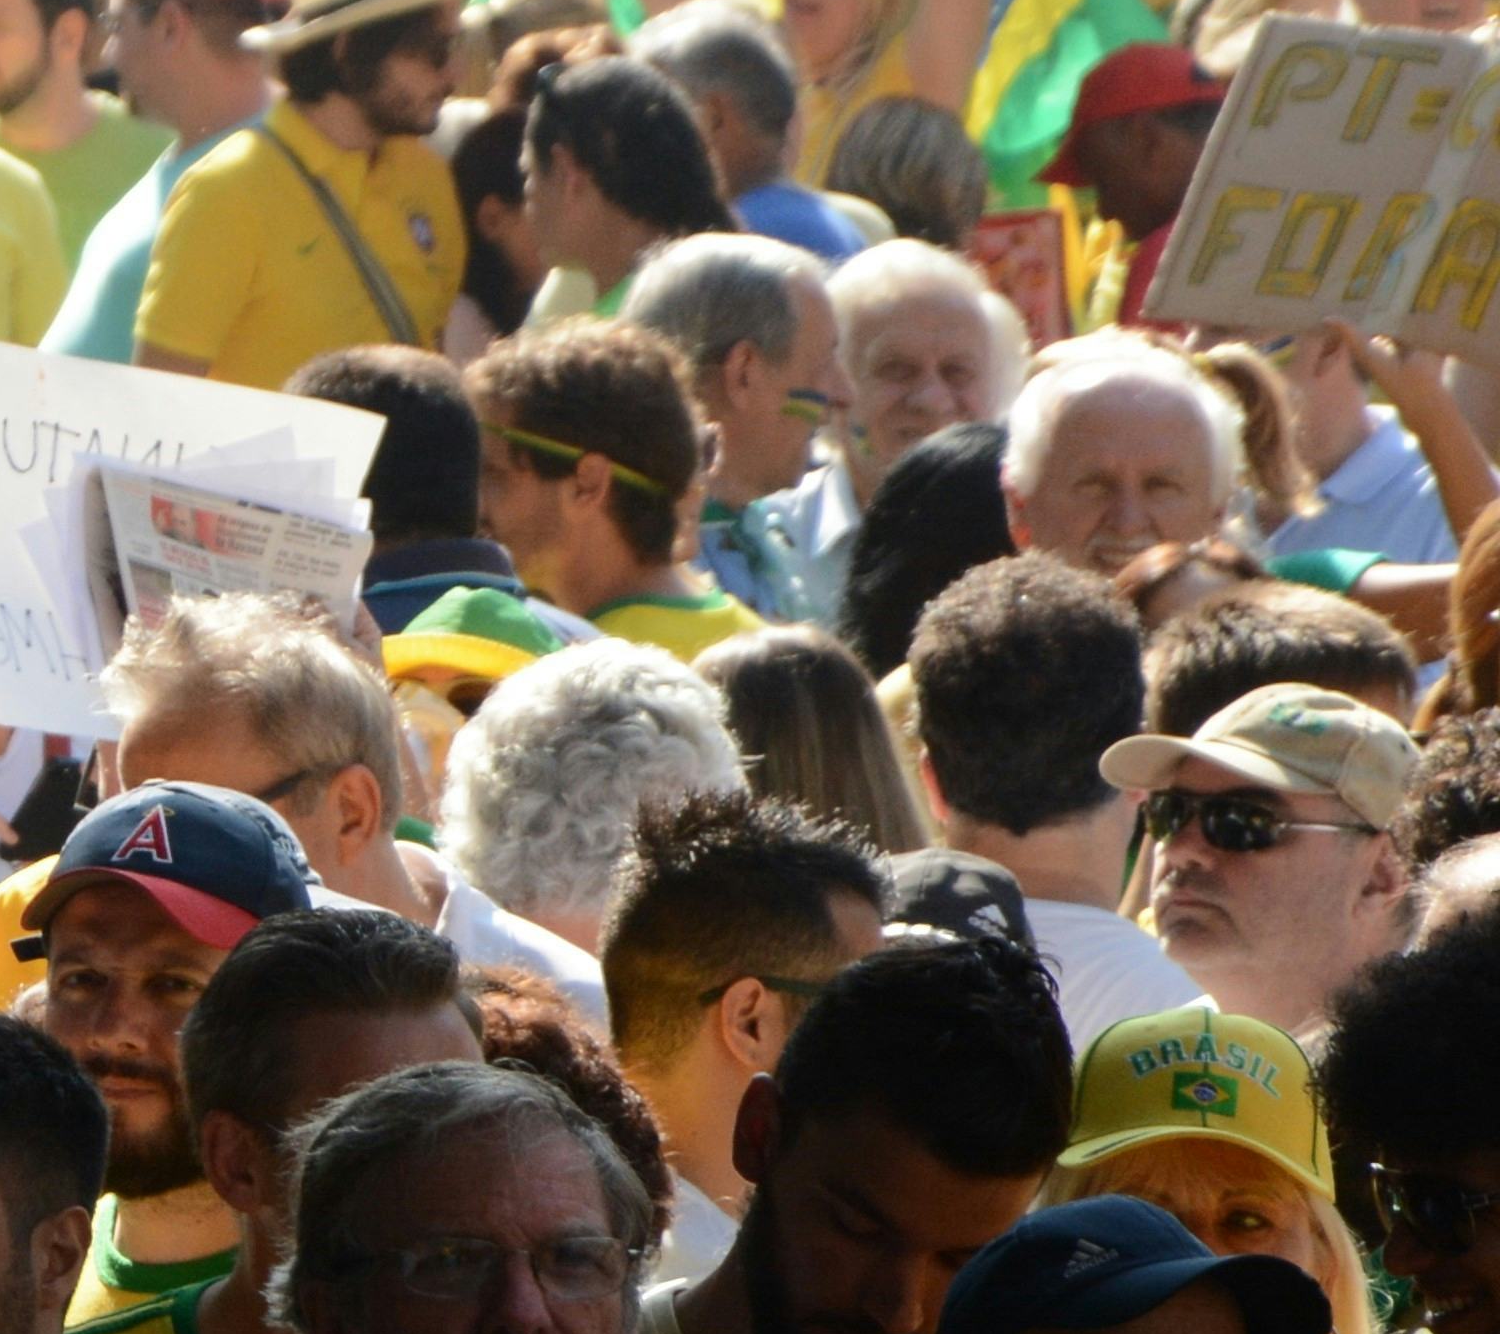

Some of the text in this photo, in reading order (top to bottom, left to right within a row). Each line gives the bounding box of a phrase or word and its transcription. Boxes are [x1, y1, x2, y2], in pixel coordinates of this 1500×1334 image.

[1188, 184, 1500, 332] FORA
[110, 802, 174, 865] A
[1126, 1032, 1283, 1101] BRASIL
